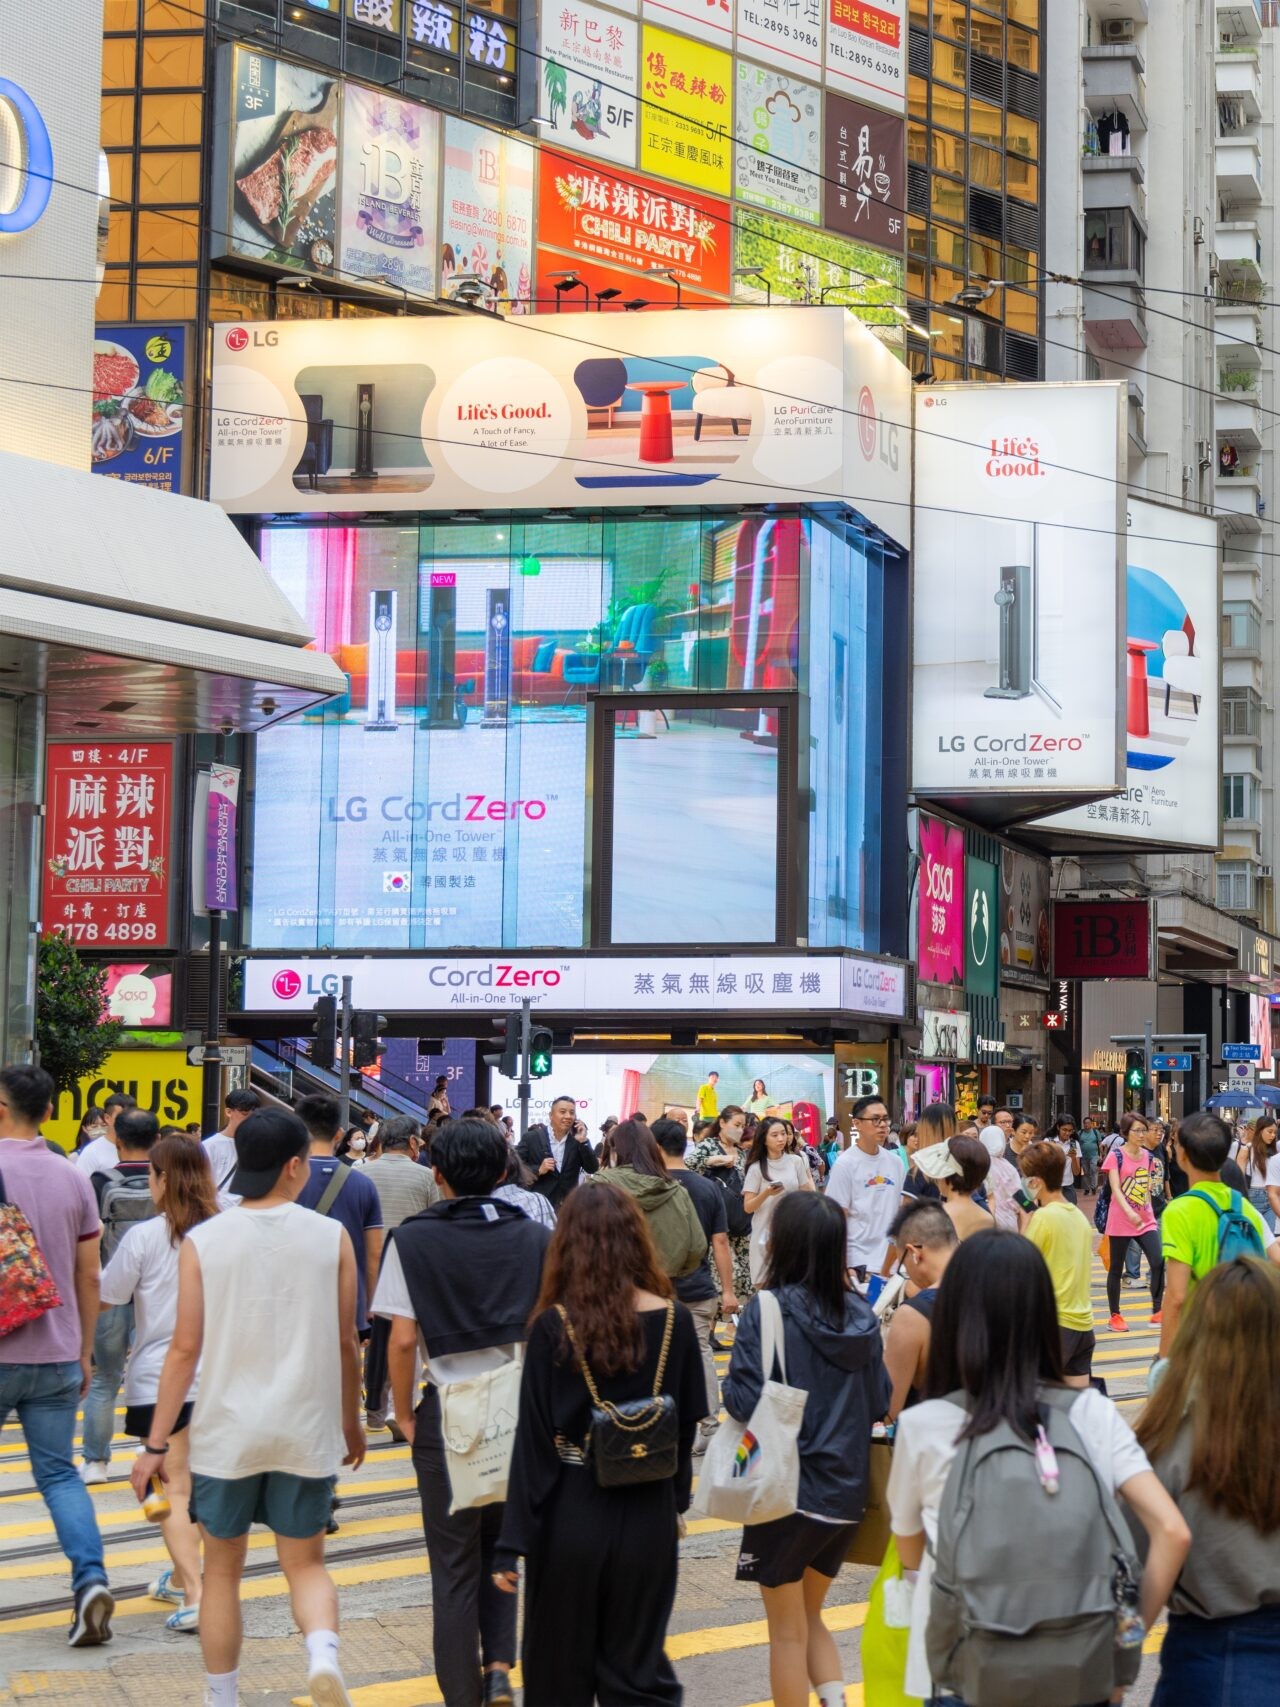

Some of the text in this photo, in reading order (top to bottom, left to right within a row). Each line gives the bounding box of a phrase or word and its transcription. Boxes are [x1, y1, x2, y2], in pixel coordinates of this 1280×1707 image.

[559, 8, 625, 51] 新巴黎
[743, 9, 818, 48] TEL:2895 3986
[545, 45, 634, 82] New Paris Vietnamese Restaurant
[830, 42, 900, 79] TEL:2895 6398
[669, 70, 727, 105] 酸辣粉
[245, 95, 263, 111] 3F
[606, 104, 634, 129] 5/F
[705, 121, 728, 143] 5/F
[647, 131, 725, 171] 正宗重慶風味
[750, 169, 806, 195] Meet You Restaurant
[580, 175, 698, 238] 麻辣派對
[482, 207, 503, 228] 2890
[888, 217, 901, 235] 5F
[635, 229, 696, 263] PARTY
[253, 330, 280, 348] LG
[457, 402, 552, 421] Life's Good.
[773, 405, 834, 415] LG PuriCare
[935, 398, 948, 407] LG
[217, 416, 284, 426] LG CordZero
[773, 416, 833, 426] AeroFurniture
[217, 427, 282, 437] All-in-One Tower
[481, 427, 502, 435] Touch
[503, 427, 512, 435] of
[143, 447, 174, 465] 6/F
[990, 437, 1039, 457] Life's
[985, 459, 1047, 477] Good.
[431, 574, 455, 585] NEW
[938, 735, 965, 753] LG
[72, 748, 149, 764] 四樓 4/F
[974, 756, 1021, 767] All-in-One
[968, 767, 1058, 780] 蒸氣無線吸塵機
[66, 774, 157, 820] 麻辣
[1151, 785, 1166, 797] Aero
[328, 796, 368, 823] LG
[1151, 798, 1179, 808] Furniture
[1087, 803, 1152, 828] 空氣清新茶几
[382, 830, 451, 843] All-in-One
[66, 825, 154, 871] 派對
[372, 847, 508, 863] 蒸氣無線吸塵機
[65, 877, 151, 893] CHILI PARTY
[63, 902, 148, 920] 外賣 訂座
[104, 923, 157, 941] 4898
[307, 973, 339, 995] LG
[633, 971, 821, 995] 蒸氣無線吸塵機
[450, 993, 506, 1004] All-in-One
[446, 1066, 464, 1081] 3F
[844, 1068, 879, 1099] iB
[506, 1098, 521, 1109] LG
